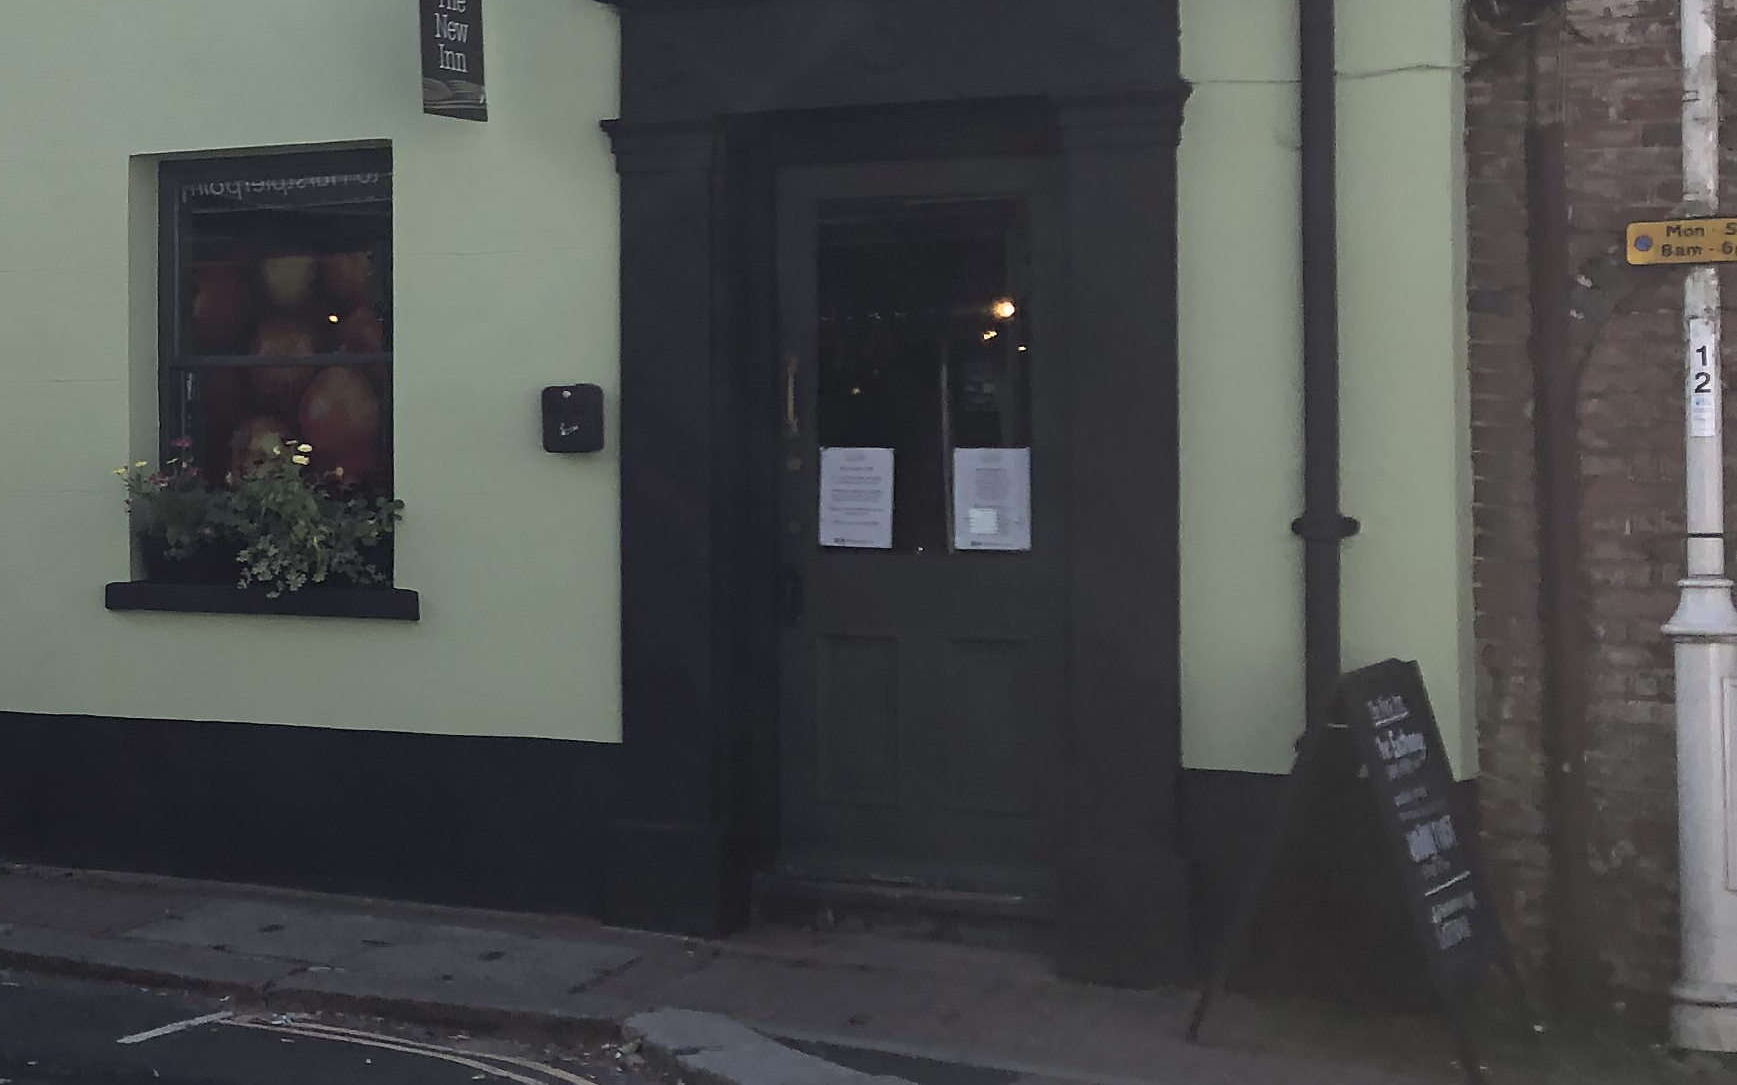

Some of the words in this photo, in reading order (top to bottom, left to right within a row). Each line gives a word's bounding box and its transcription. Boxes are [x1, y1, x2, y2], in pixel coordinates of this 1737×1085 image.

[434, 12, 469, 43] New
[438, 43, 468, 73] Inn
[1666, 224, 1705, 237] Mon
